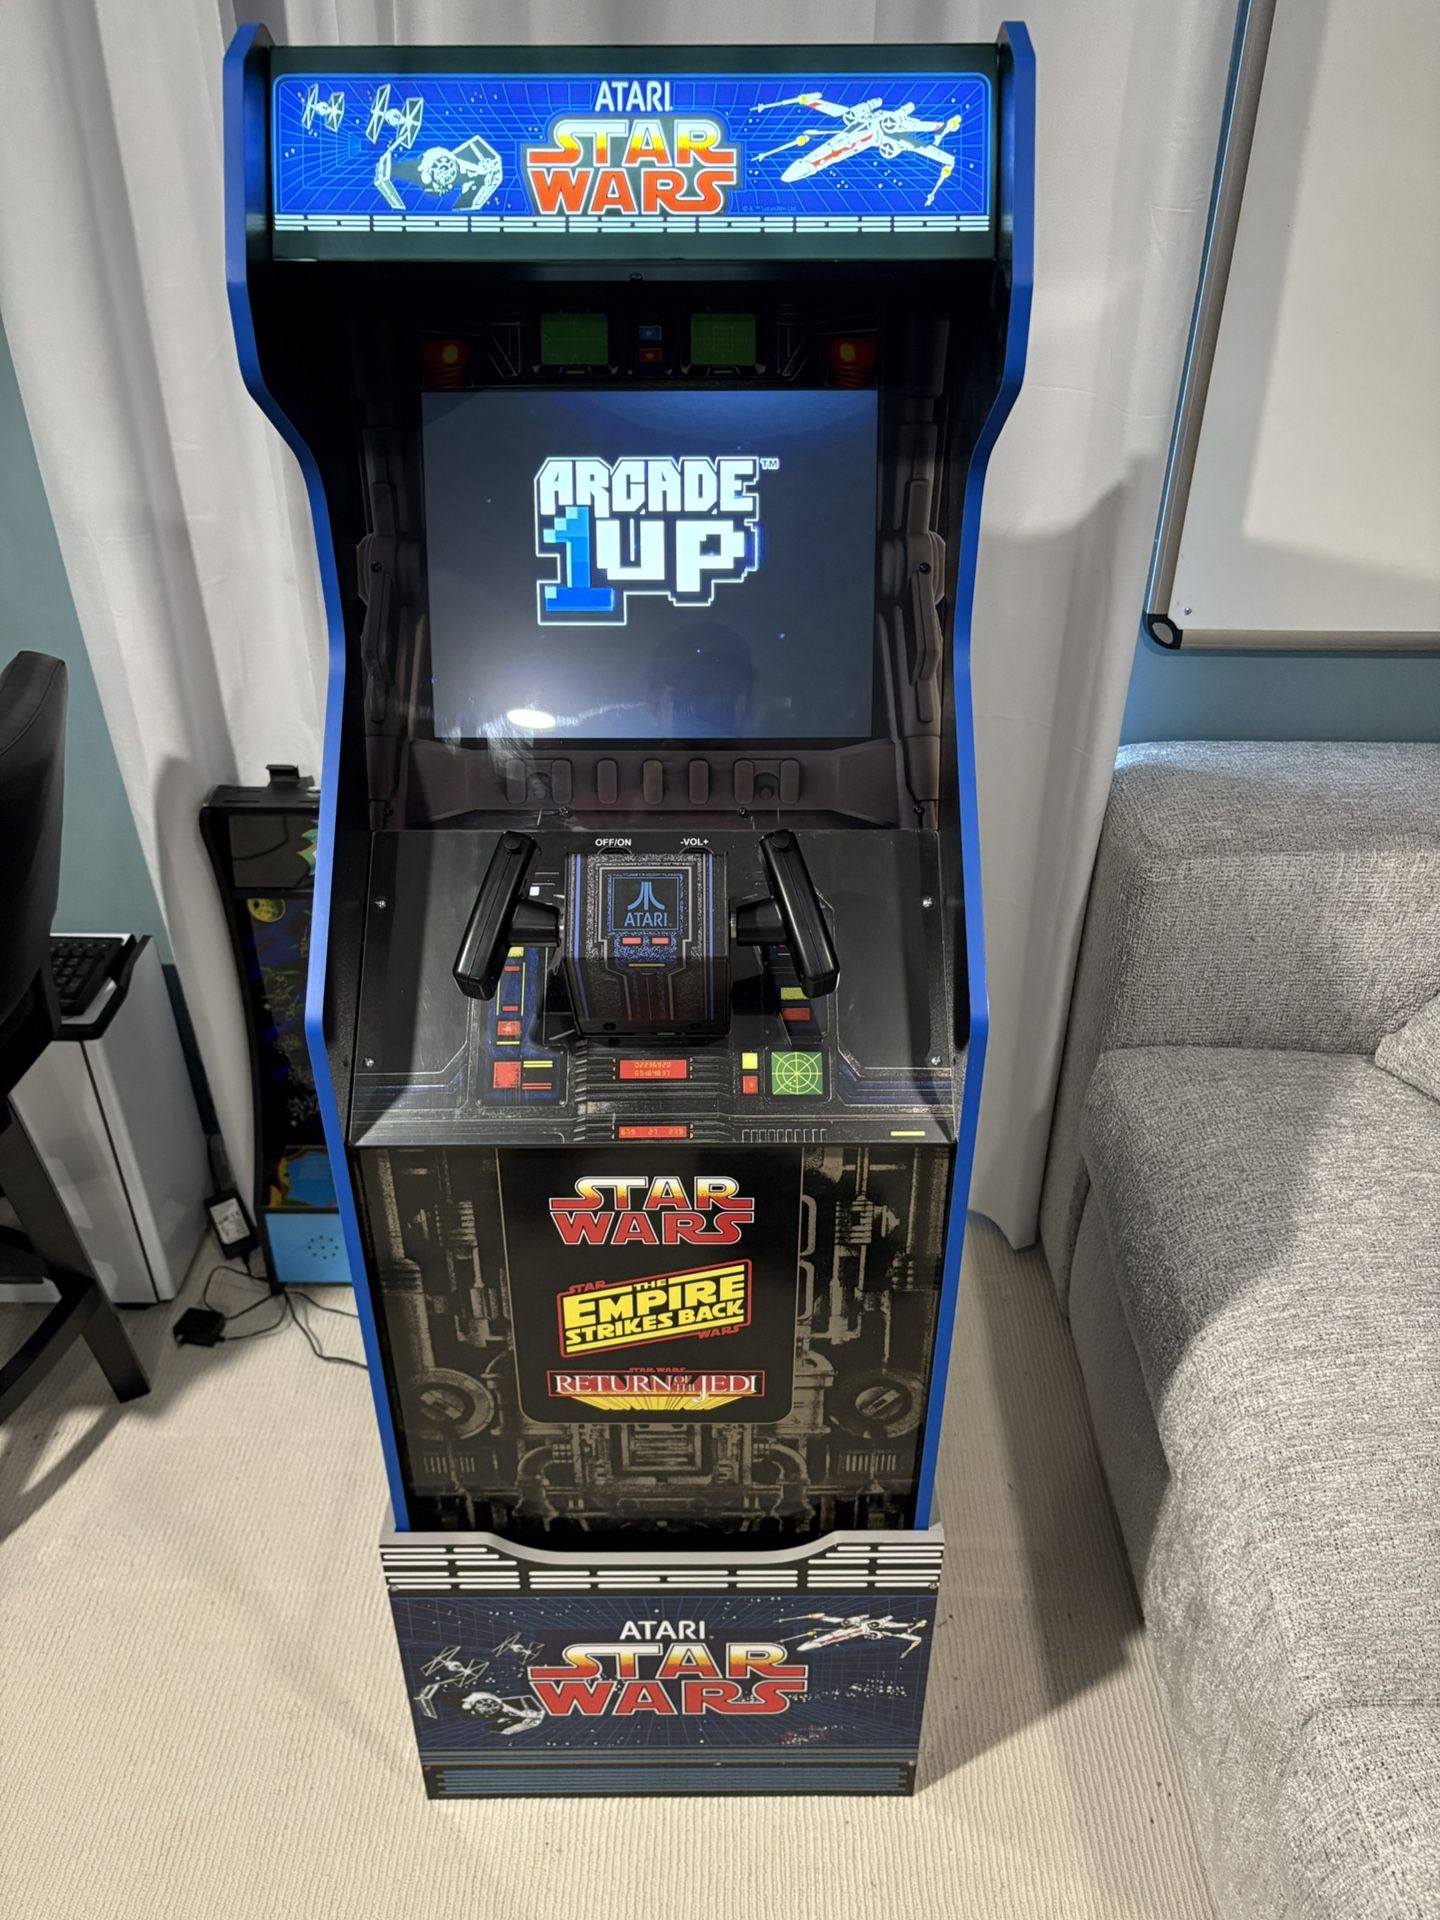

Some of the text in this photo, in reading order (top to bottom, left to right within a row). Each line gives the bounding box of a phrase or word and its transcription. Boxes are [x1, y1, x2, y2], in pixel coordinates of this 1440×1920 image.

[594, 80, 672, 112] ATARI
[526, 119, 737, 167] STAR
[527, 167, 737, 215] WARS
[538, 459, 755, 517] ARCADE
[595, 838, 632, 847] OFF/ON
[624, 912, 668, 927] ATARI
[549, 1176, 755, 1210] STAR
[550, 1211, 755, 1245] WARS
[563, 1274, 745, 1329] EMPIRE
[568, 1280, 607, 1294] STAR
[633, 1278, 667, 1291] THE
[565, 1299, 745, 1345] STRIKES BACK
[697, 1324, 740, 1339] WARS
[555, 1375, 673, 1393] RETURN
[692, 1375, 757, 1404] JEDI
[619, 1620, 706, 1640] ATARI
[527, 1643, 808, 1679] STAR
[529, 1680, 808, 1716] WARS
